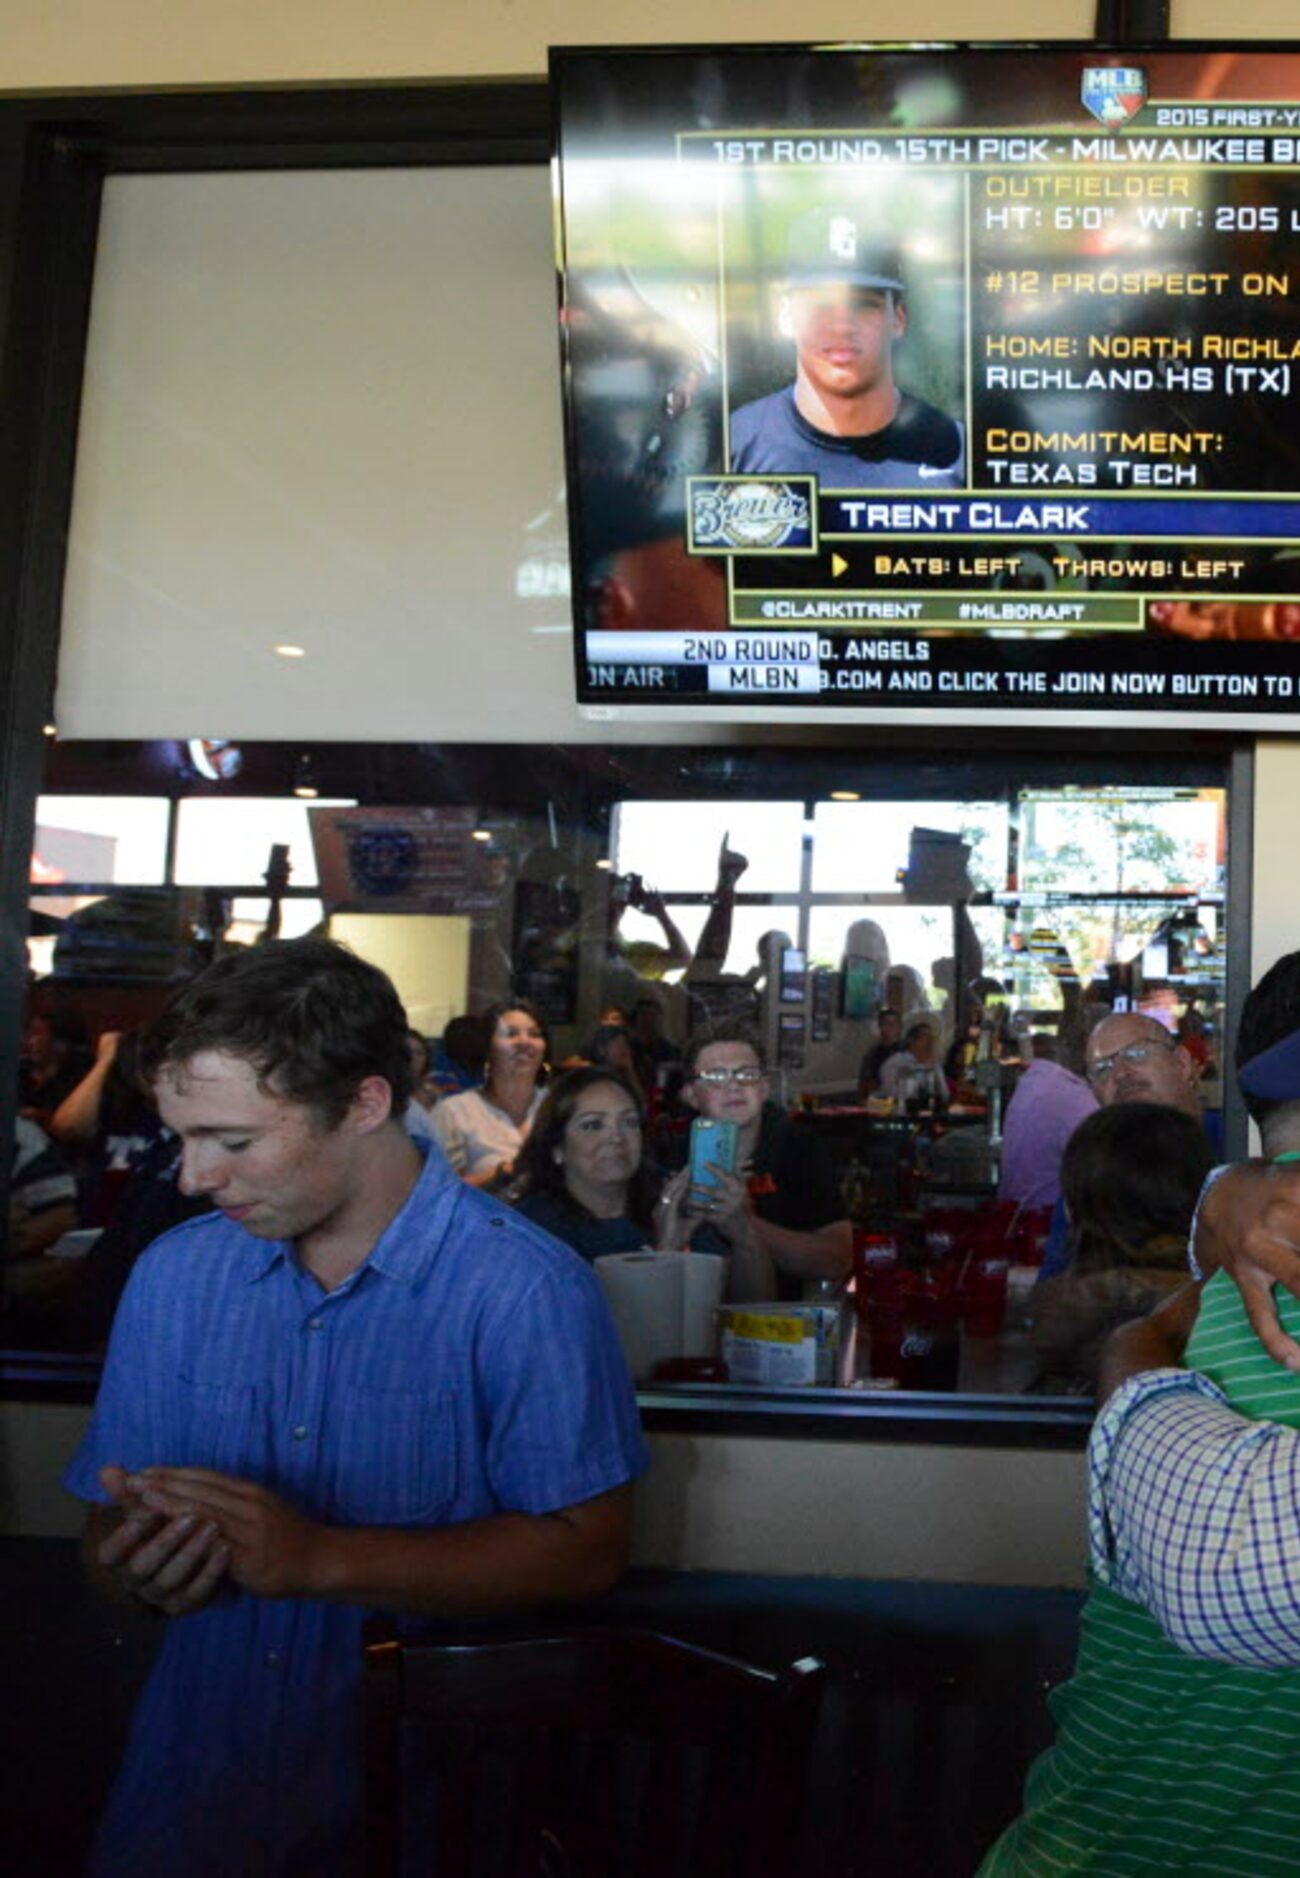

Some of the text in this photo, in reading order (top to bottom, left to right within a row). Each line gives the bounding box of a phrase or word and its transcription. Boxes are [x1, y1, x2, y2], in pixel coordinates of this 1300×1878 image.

[1156, 109, 1208, 127] 2015
[712, 140, 767, 164] 1ST
[772, 140, 890, 164] ROUND,
[896, 140, 971, 164] 15TH
[978, 140, 1049, 164] PICK
[1072, 140, 1265, 165] MILWAUKEE
[985, 175, 1190, 198] OUTFIELDER
[985, 207, 1043, 230] HT:
[1138, 208, 1204, 231] WT:
[1215, 208, 1279, 231] 205
[985, 272, 1040, 294] #12
[1052, 273, 1229, 296] PROSPECT
[1241, 274, 1289, 296] ON
[985, 335, 1078, 358] HOME:
[1087, 335, 1193, 359] NORTH
[985, 365, 1153, 391] RICHLAND
[1166, 367, 1215, 391] HS
[985, 429, 1225, 455] COMMITMENT:
[986, 459, 1198, 485] TEXAS TECH
[839, 502, 1091, 531] TRENT CLARK
[874, 556, 1246, 579] BATS: LEFT THROWS: LEFT
[959, 603, 1085, 622] #MLBDRAFT
[684, 638, 811, 662] 2ND ROUND
[845, 640, 930, 661] ANGELS
[623, 668, 664, 688] AIR
[729, 667, 799, 689] MLBN
[888, 670, 932, 691] AND
[938, 670, 999, 692] CLICK
[1004, 671, 1047, 692] THE
[1052, 672, 1105, 694] JOIN
[1111, 673, 1166, 694] NOW
[1172, 674, 1258, 696] BUTTON
[1264, 676, 1292, 696] TO
